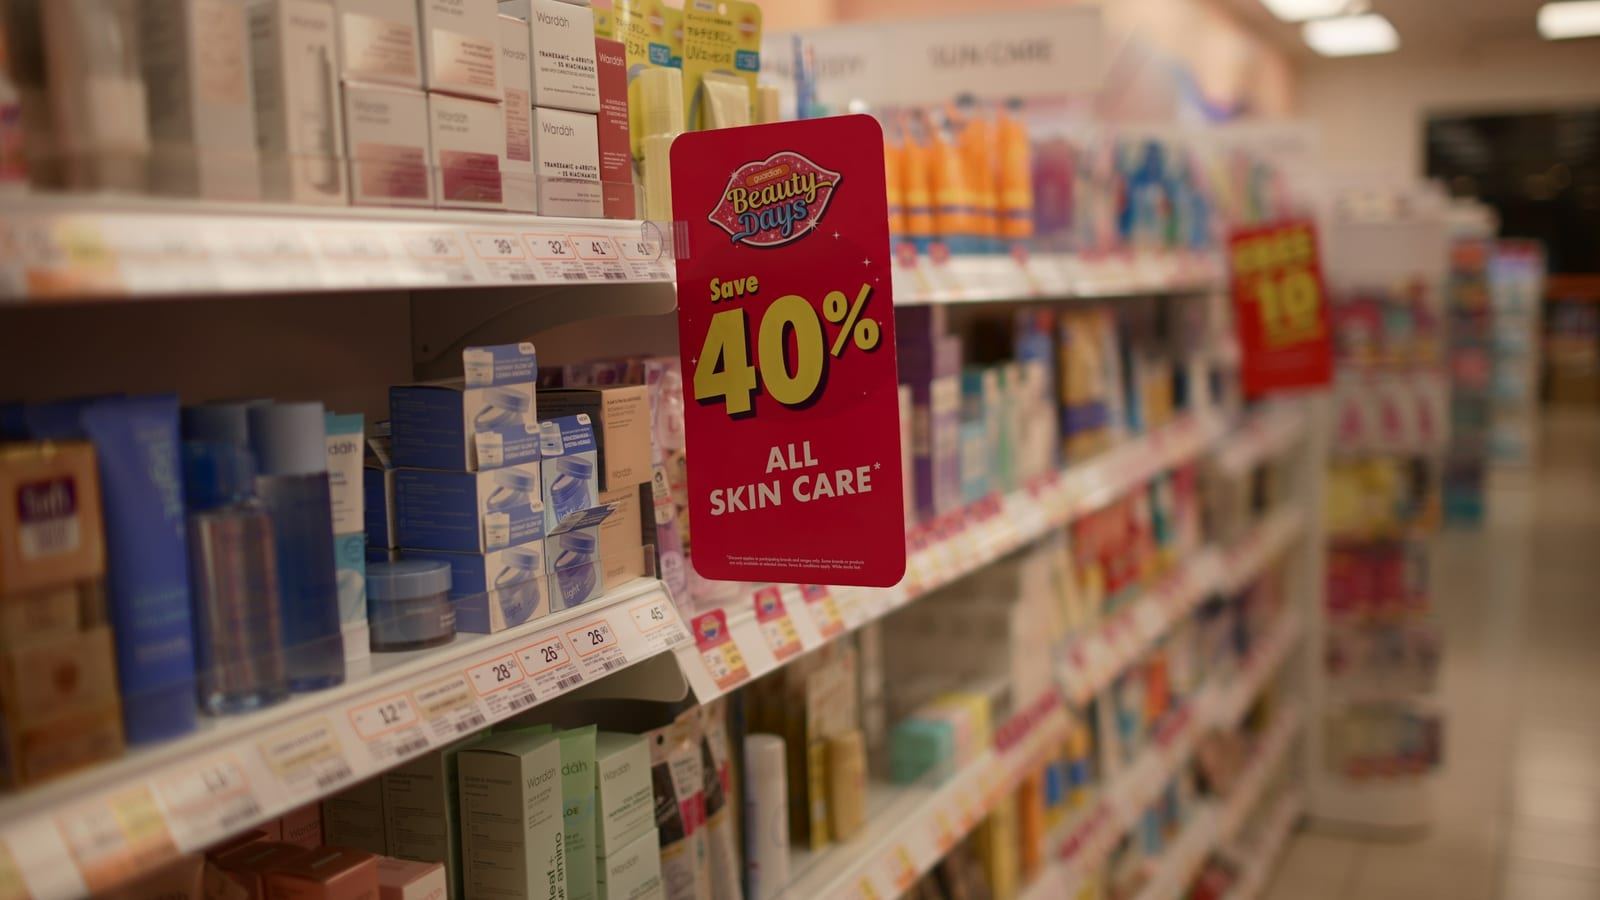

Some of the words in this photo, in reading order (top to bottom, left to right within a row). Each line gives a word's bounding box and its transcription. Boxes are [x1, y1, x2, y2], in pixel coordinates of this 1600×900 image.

[752, 168, 783, 184] guardian
[726, 171, 833, 215] Beauty
[731, 199, 809, 243] Days
[547, 240, 566, 255] 32
[591, 241, 606, 256] 41
[709, 275, 760, 303] Save
[693, 282, 882, 418] 40%
[765, 440, 819, 474] ALL
[709, 480, 782, 517] SKIN
[587, 629, 605, 646] 26
[540, 646, 559, 663] 26
[492, 663, 511, 682] 28
[560, 760, 589, 778] dah
